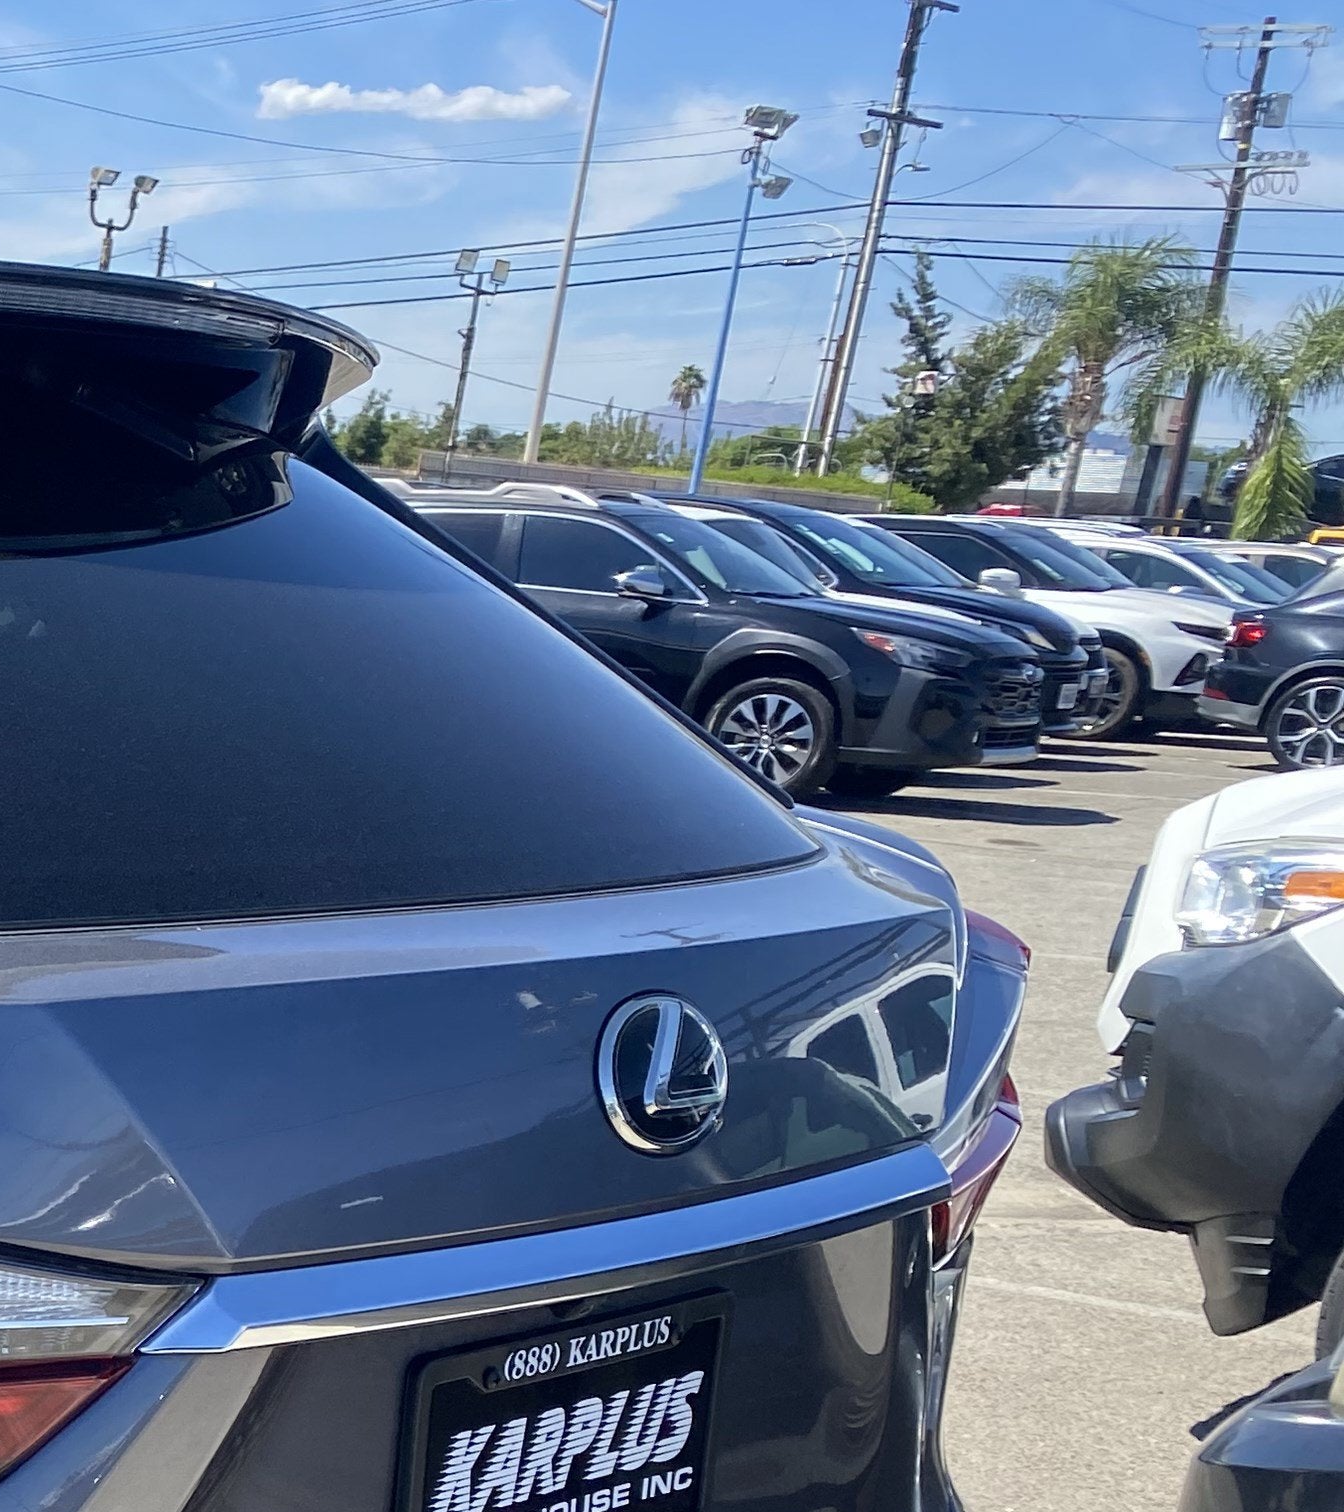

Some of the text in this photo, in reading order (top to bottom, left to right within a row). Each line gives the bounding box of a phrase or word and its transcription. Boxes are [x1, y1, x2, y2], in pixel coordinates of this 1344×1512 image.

[504, 1316, 671, 1381] (888) KARPLUS
[641, 1466, 693, 1500] INC
